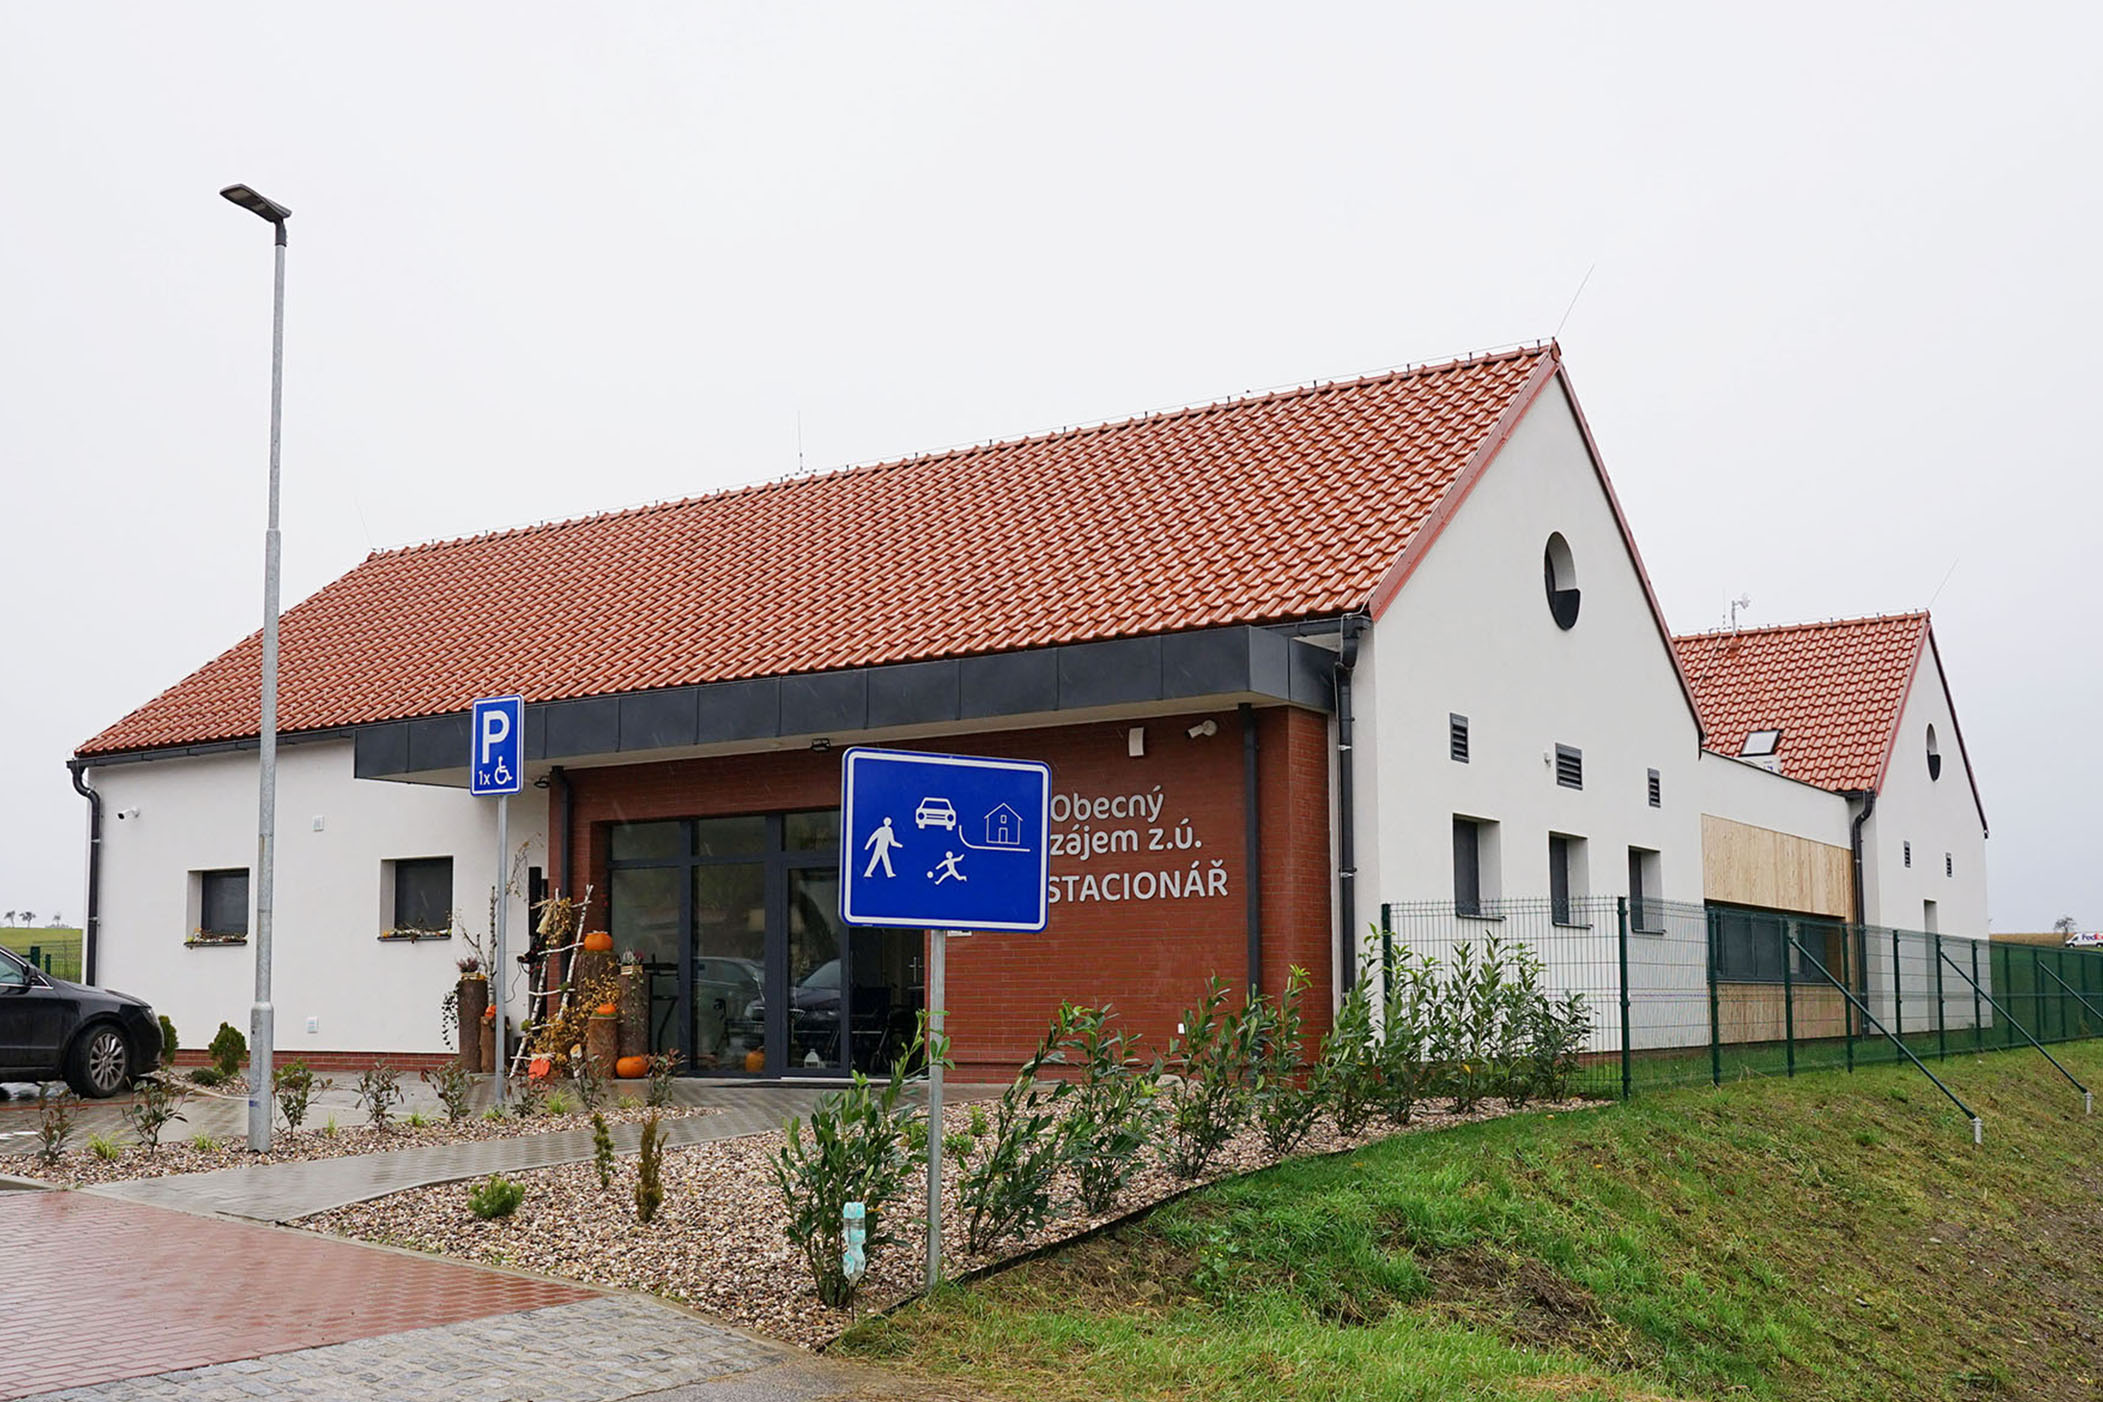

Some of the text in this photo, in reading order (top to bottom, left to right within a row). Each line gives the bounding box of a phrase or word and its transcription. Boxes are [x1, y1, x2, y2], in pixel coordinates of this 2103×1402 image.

[482, 710, 510, 764] P
[479, 770, 491, 785] 1x
[1050, 784, 1164, 823] Obecný
[1050, 823, 1139, 861] zájem
[1048, 858, 1229, 904] STACIONÁŘ
